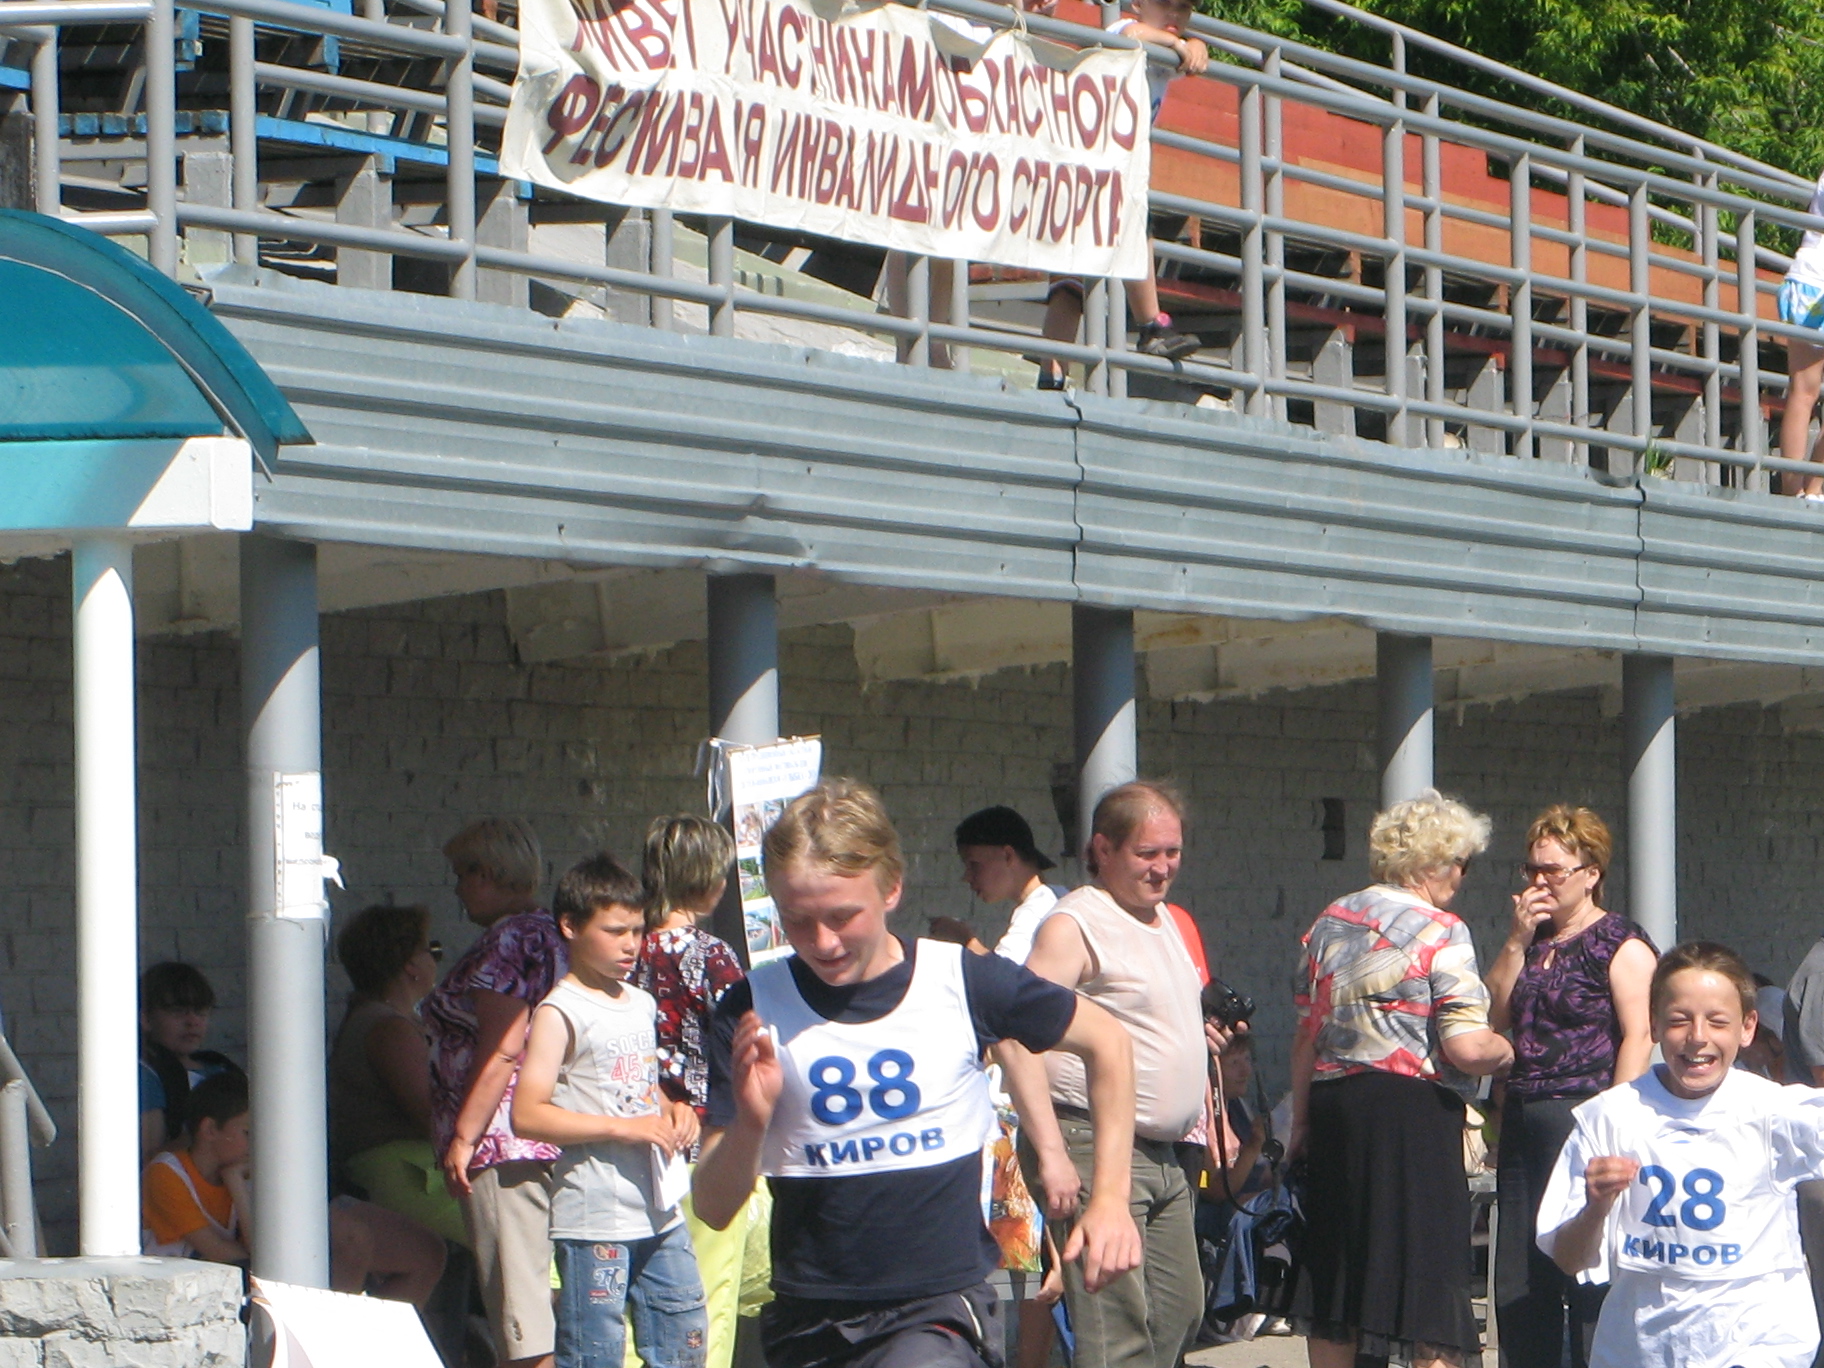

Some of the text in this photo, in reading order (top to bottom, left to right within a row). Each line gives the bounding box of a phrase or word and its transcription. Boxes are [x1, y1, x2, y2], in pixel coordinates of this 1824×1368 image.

[611, 1053, 643, 1084] 45
[810, 1048, 921, 1125] 88
[805, 1127, 944, 1168] КИРОВ
[1639, 1164, 1726, 1231] 28
[1624, 1234, 1743, 1265] КИРОВ
